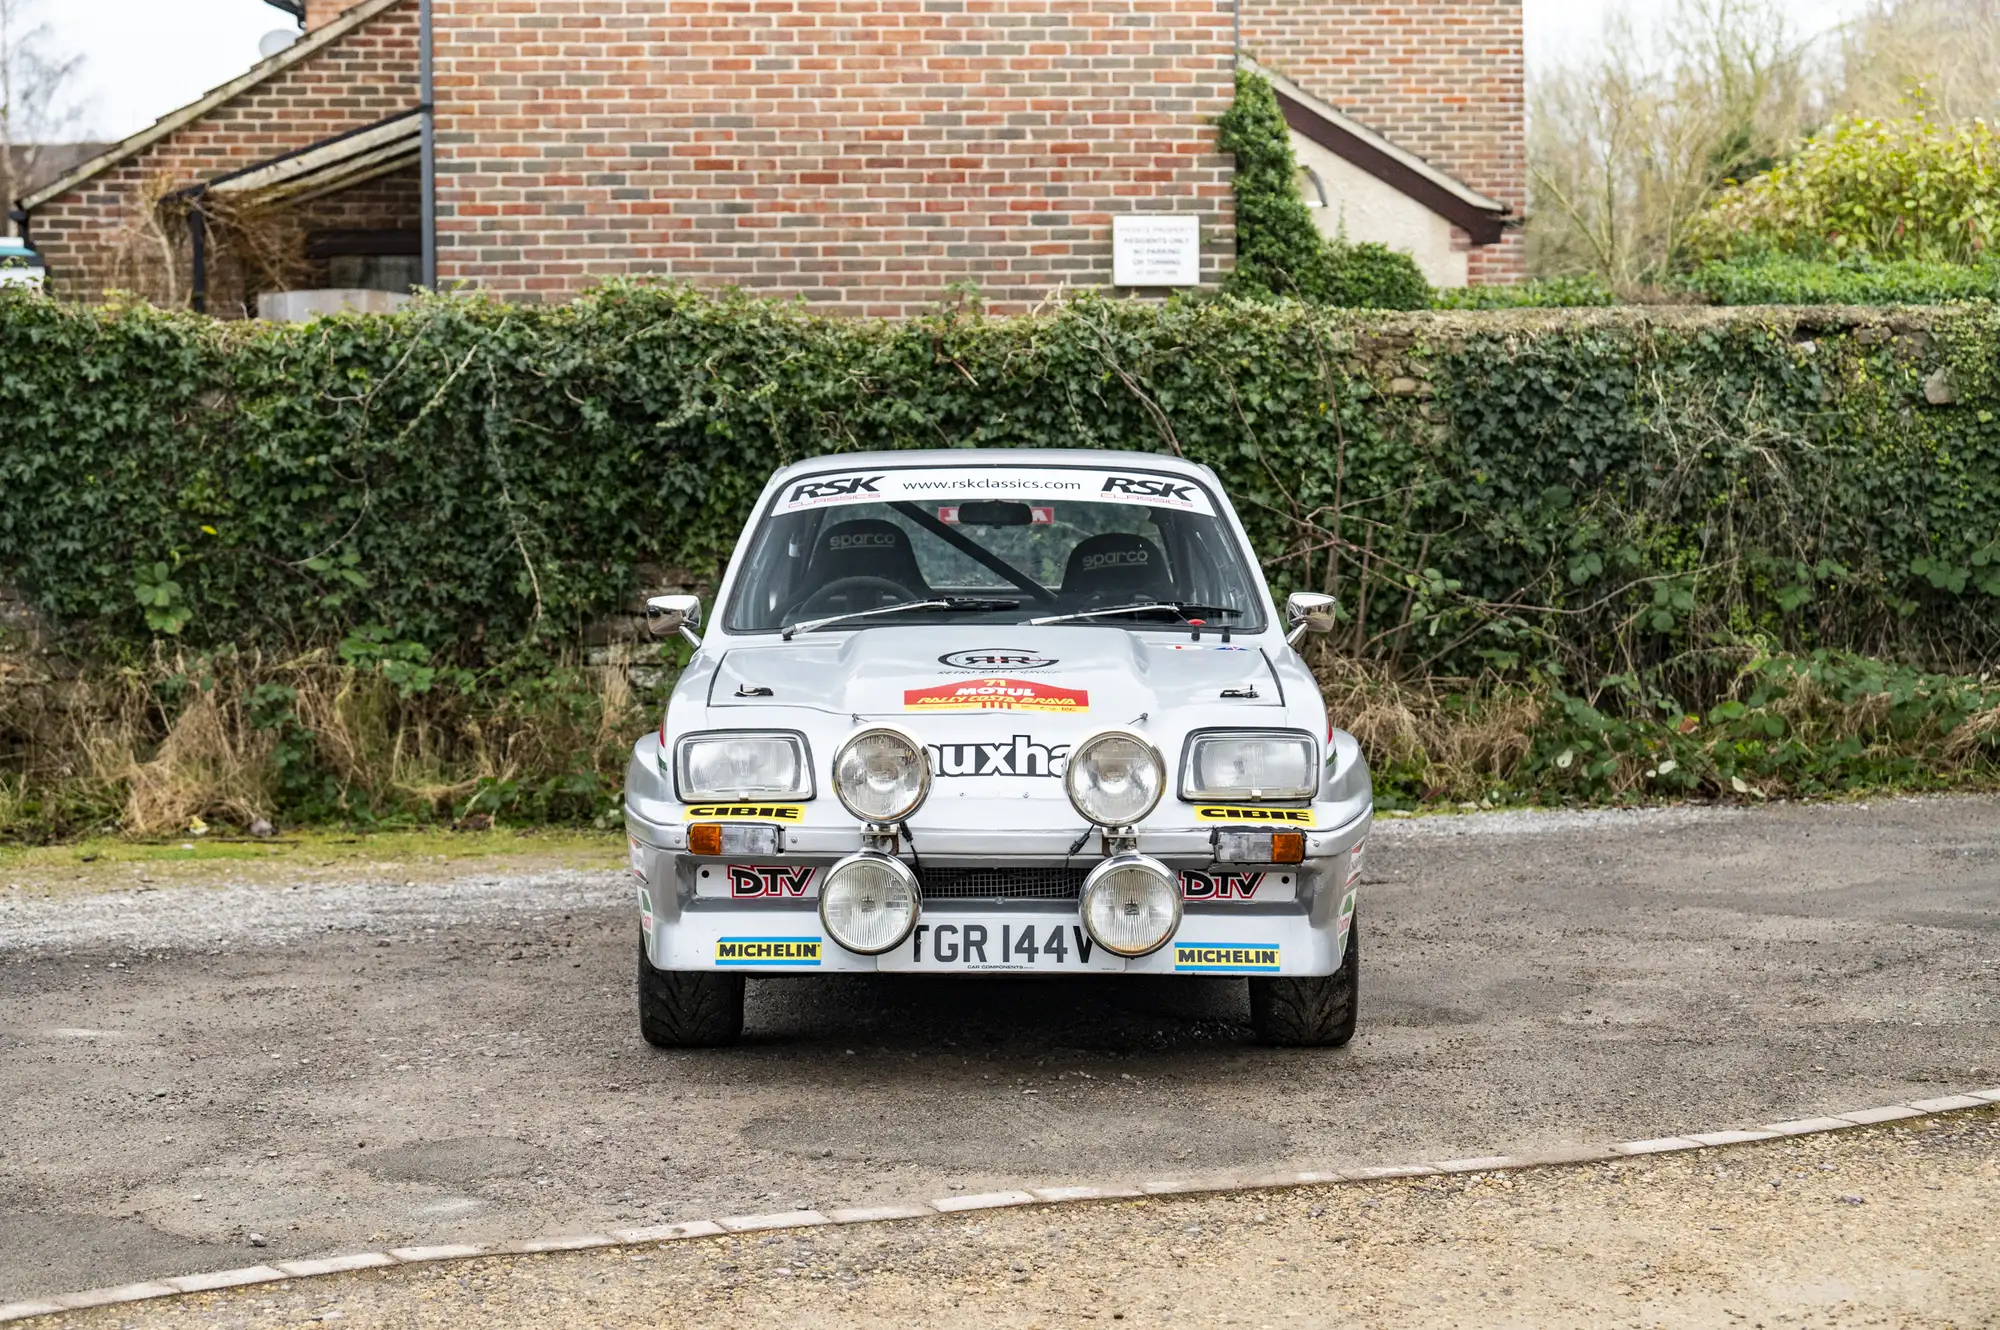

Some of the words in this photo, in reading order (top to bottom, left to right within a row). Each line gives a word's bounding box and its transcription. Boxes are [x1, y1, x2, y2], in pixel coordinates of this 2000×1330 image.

[789, 476, 886, 502] RSK
[902, 478, 1081, 490] www.rskclassics.com
[1101, 477, 1197, 502] RSK
[788, 493, 881, 509] CLASSICS
[1101, 493, 1193, 508] CLASSICS
[829, 532, 896, 547] sparco
[1082, 548, 1149, 566] sparco
[955, 687, 1035, 697] MOTUL
[917, 695, 968, 704] RALLY
[967, 695, 1017, 703] COSTA
[1020, 697, 1077, 705] BRAVA
[1200, 808, 1310, 822] CIBIE
[729, 866, 815, 896] DTV
[1181, 870, 1264, 897] DTV
[719, 944, 817, 957] MICHELIN
[912, 924, 988, 963] TGR
[1003, 924, 1094, 963] 144V
[1178, 949, 1276, 964] MICHELIN
